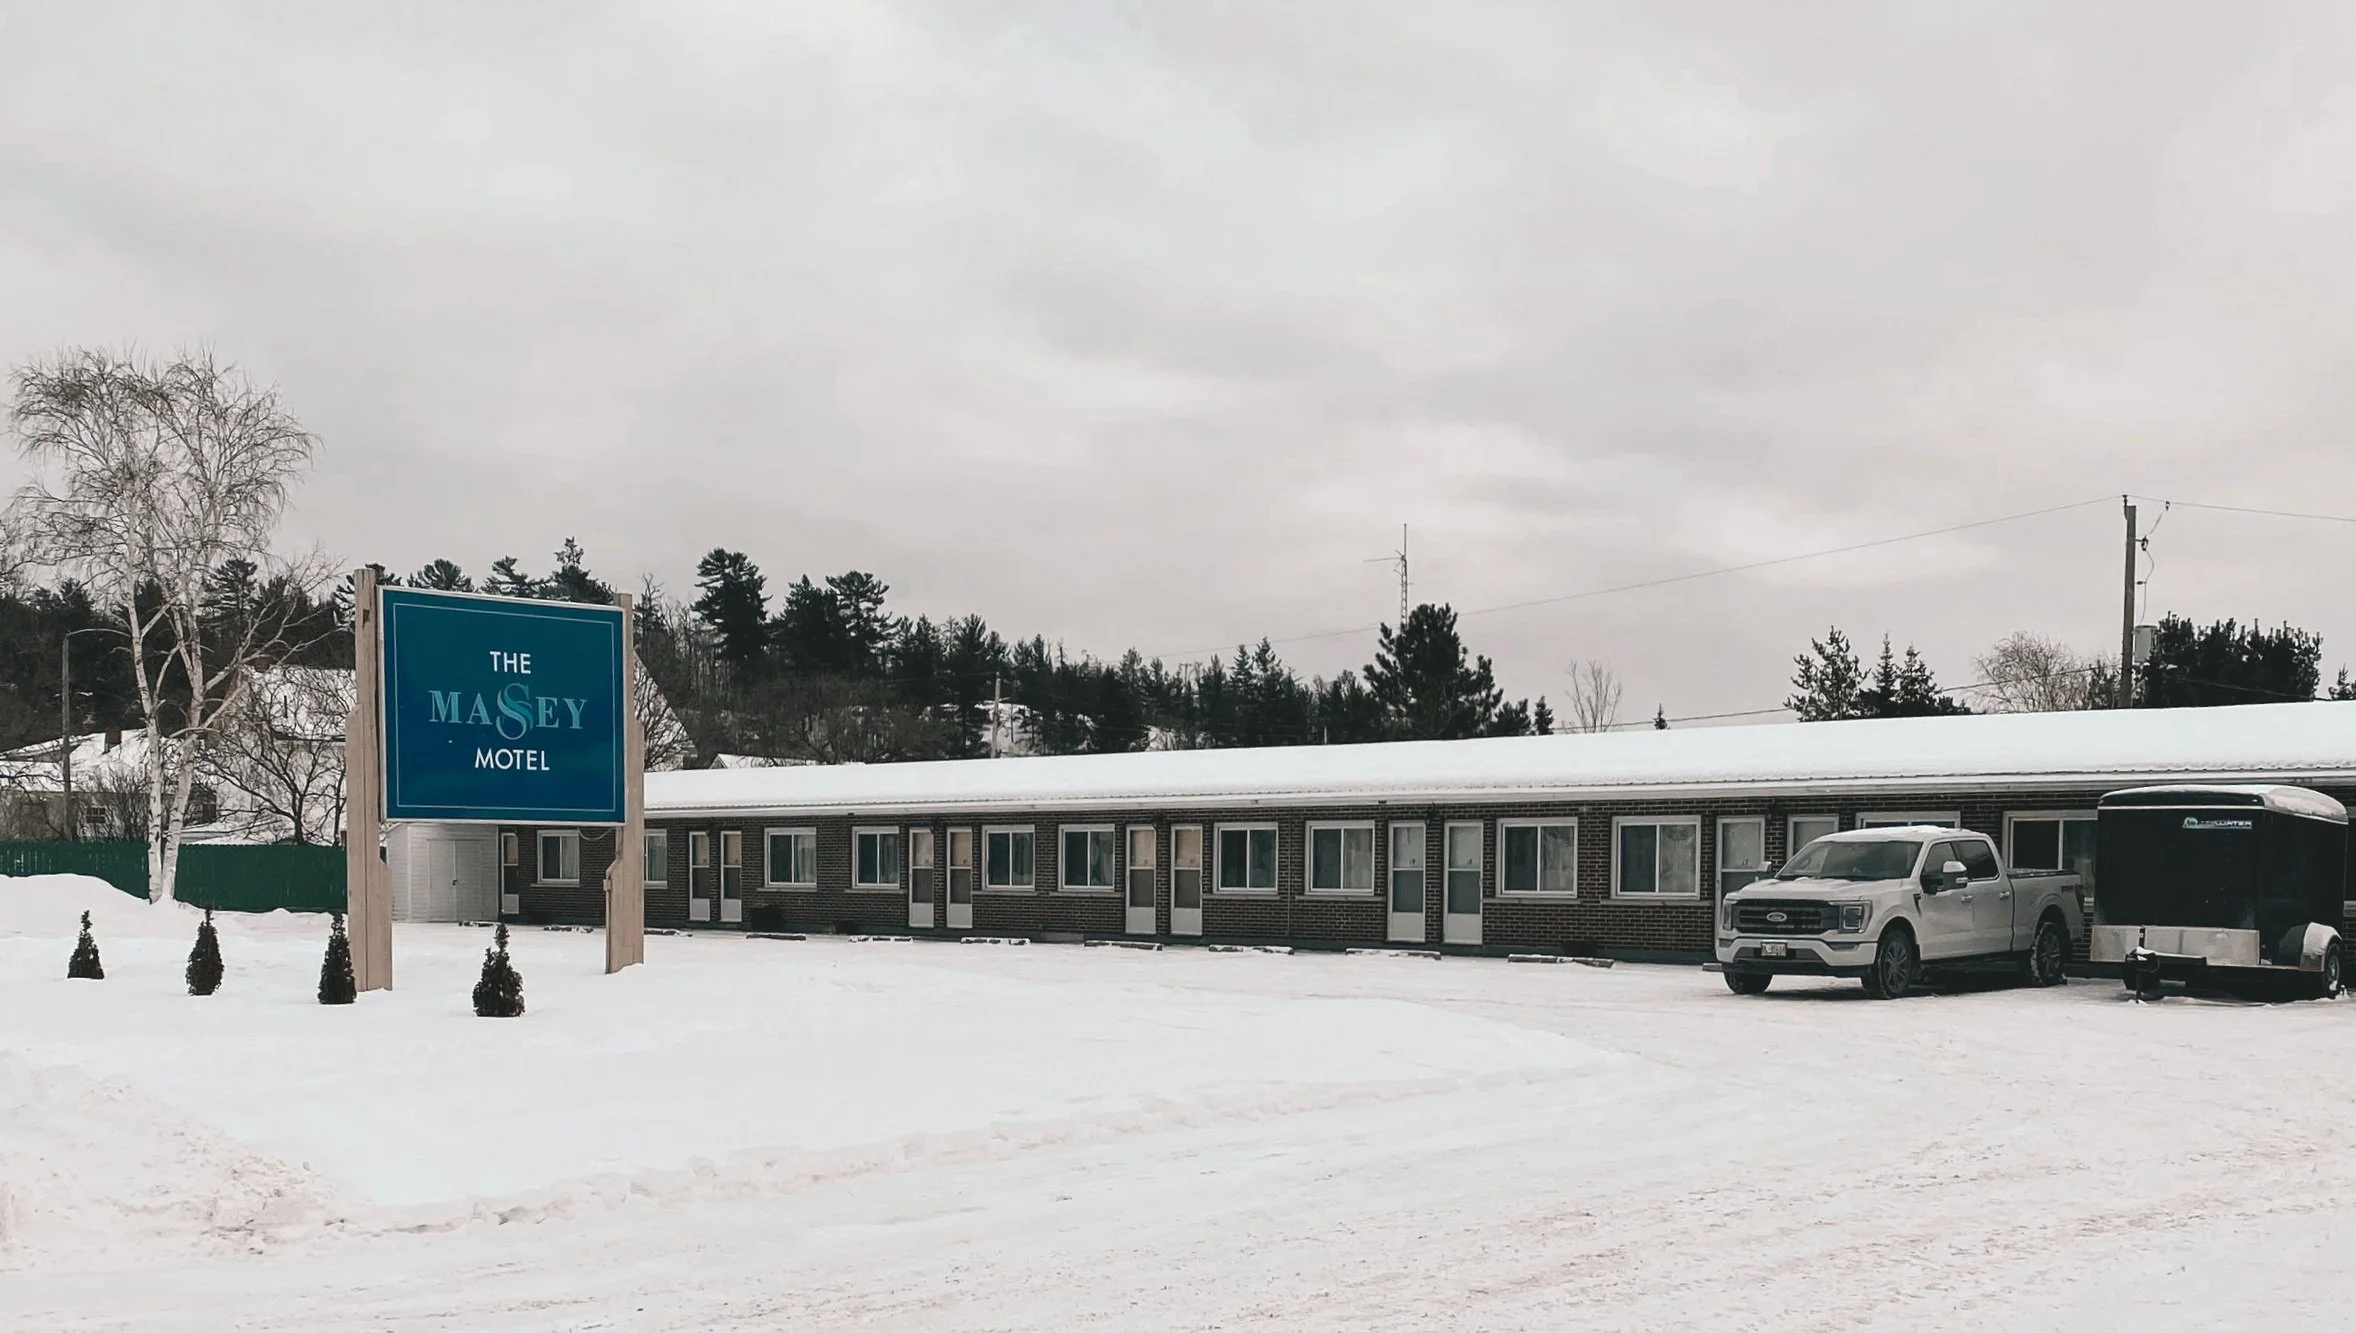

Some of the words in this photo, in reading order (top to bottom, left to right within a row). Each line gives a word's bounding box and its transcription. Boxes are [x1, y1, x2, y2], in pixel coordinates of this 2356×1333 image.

[489, 650, 532, 674] THE
[428, 682, 588, 740] MASSEY
[474, 747, 550, 771] MOTEL
